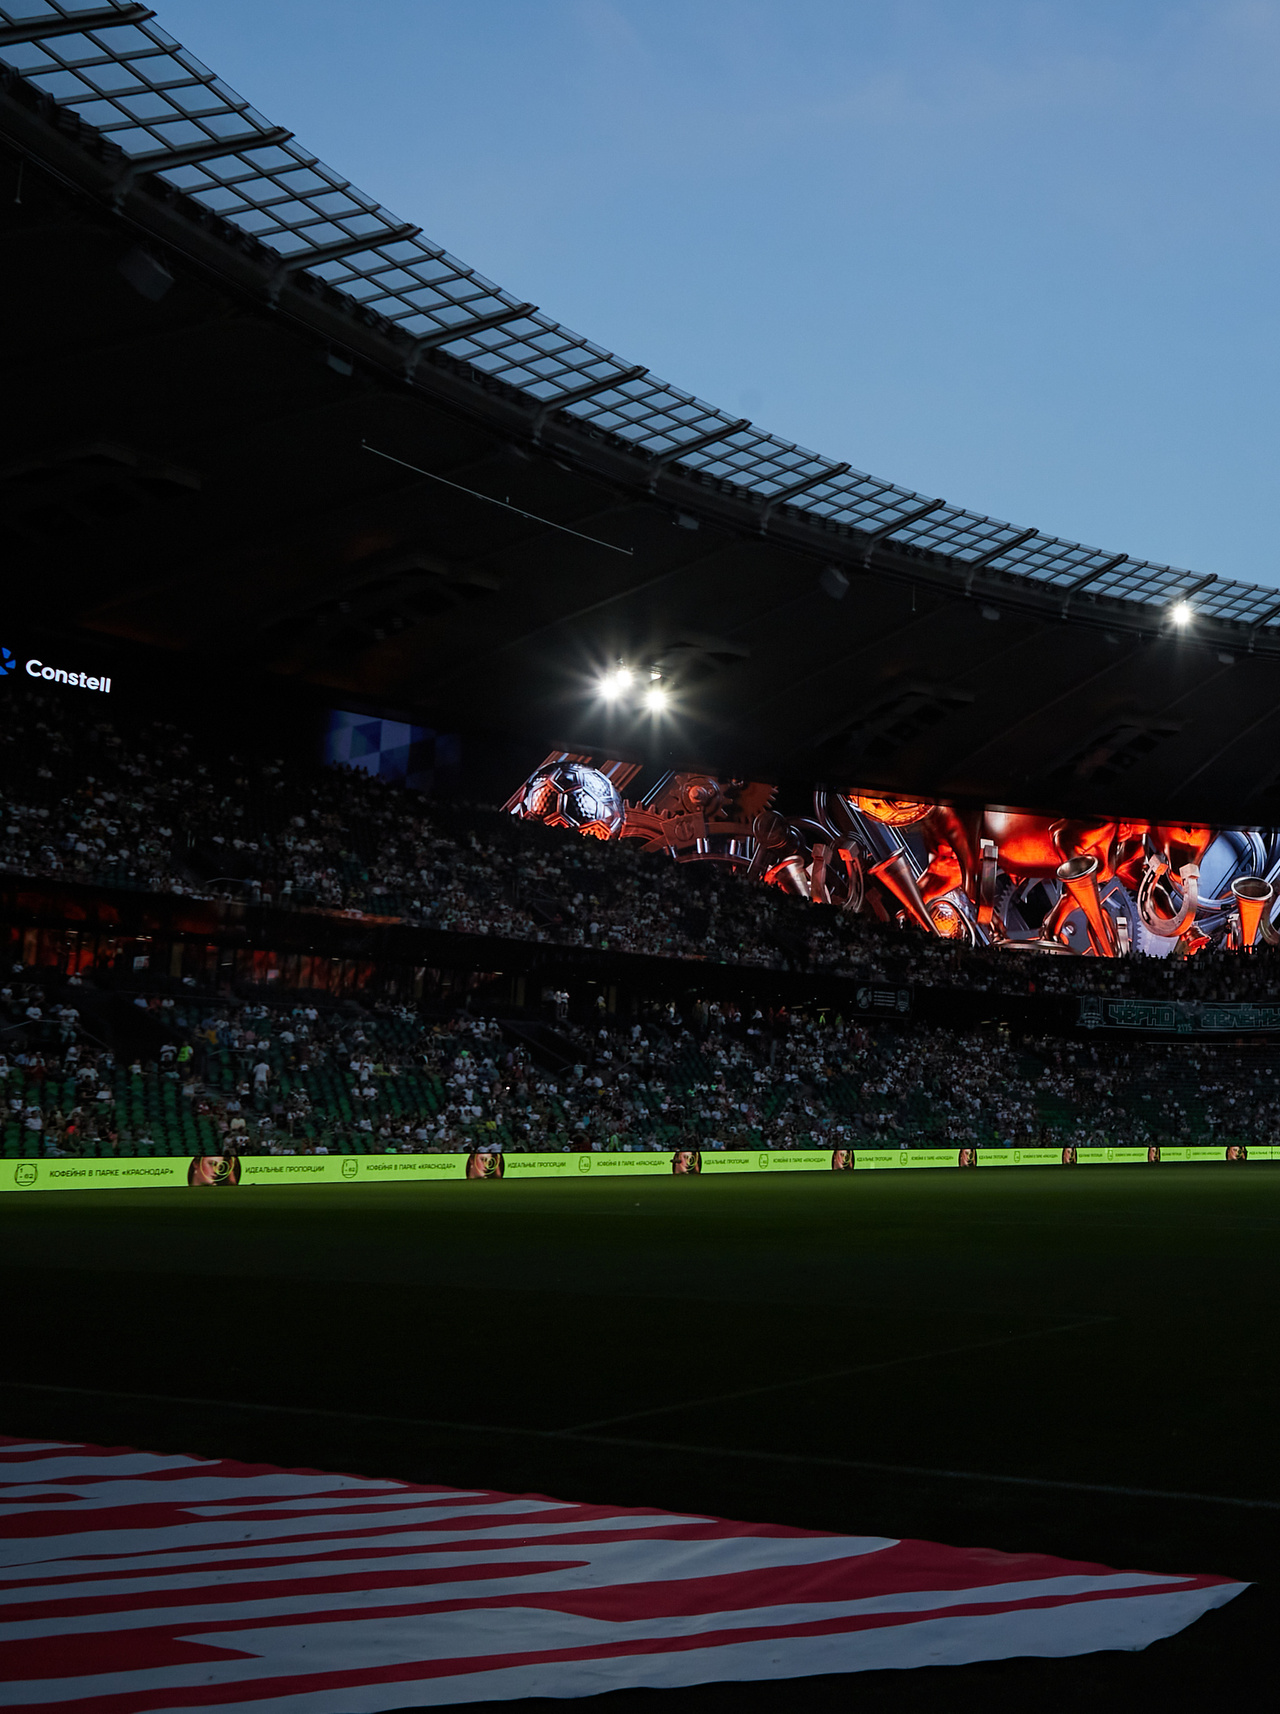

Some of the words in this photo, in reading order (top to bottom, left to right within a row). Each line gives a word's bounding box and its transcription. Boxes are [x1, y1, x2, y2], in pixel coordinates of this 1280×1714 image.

[26, 659, 111, 693] Constell
[49, 1168, 86, 1178] КОФЕЙНЯ
[95, 1169, 119, 1177] ПАРКЕ
